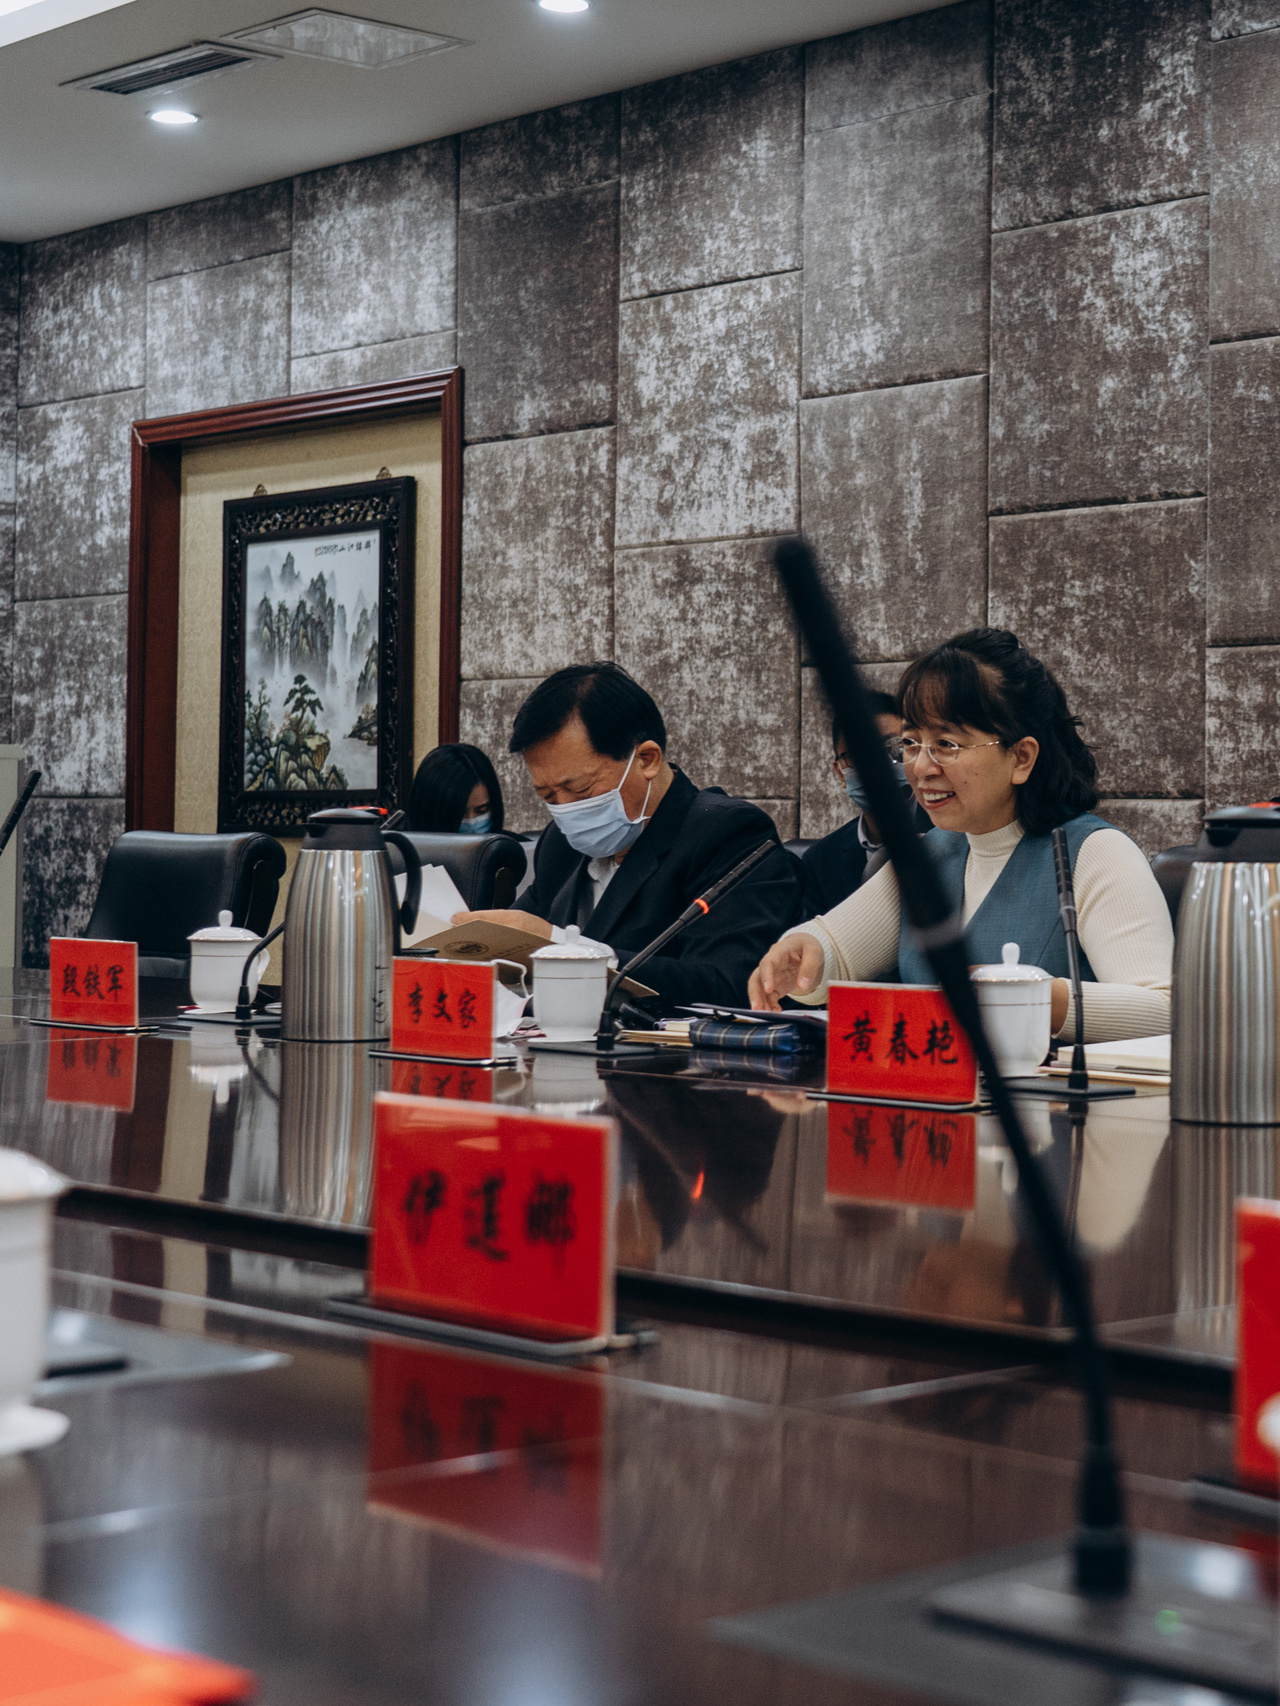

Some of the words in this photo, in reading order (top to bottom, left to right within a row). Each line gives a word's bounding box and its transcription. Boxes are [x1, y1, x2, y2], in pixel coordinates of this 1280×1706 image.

[408, 981, 478, 1029] 李文家
[843, 1010, 959, 1066] 黄春艳
